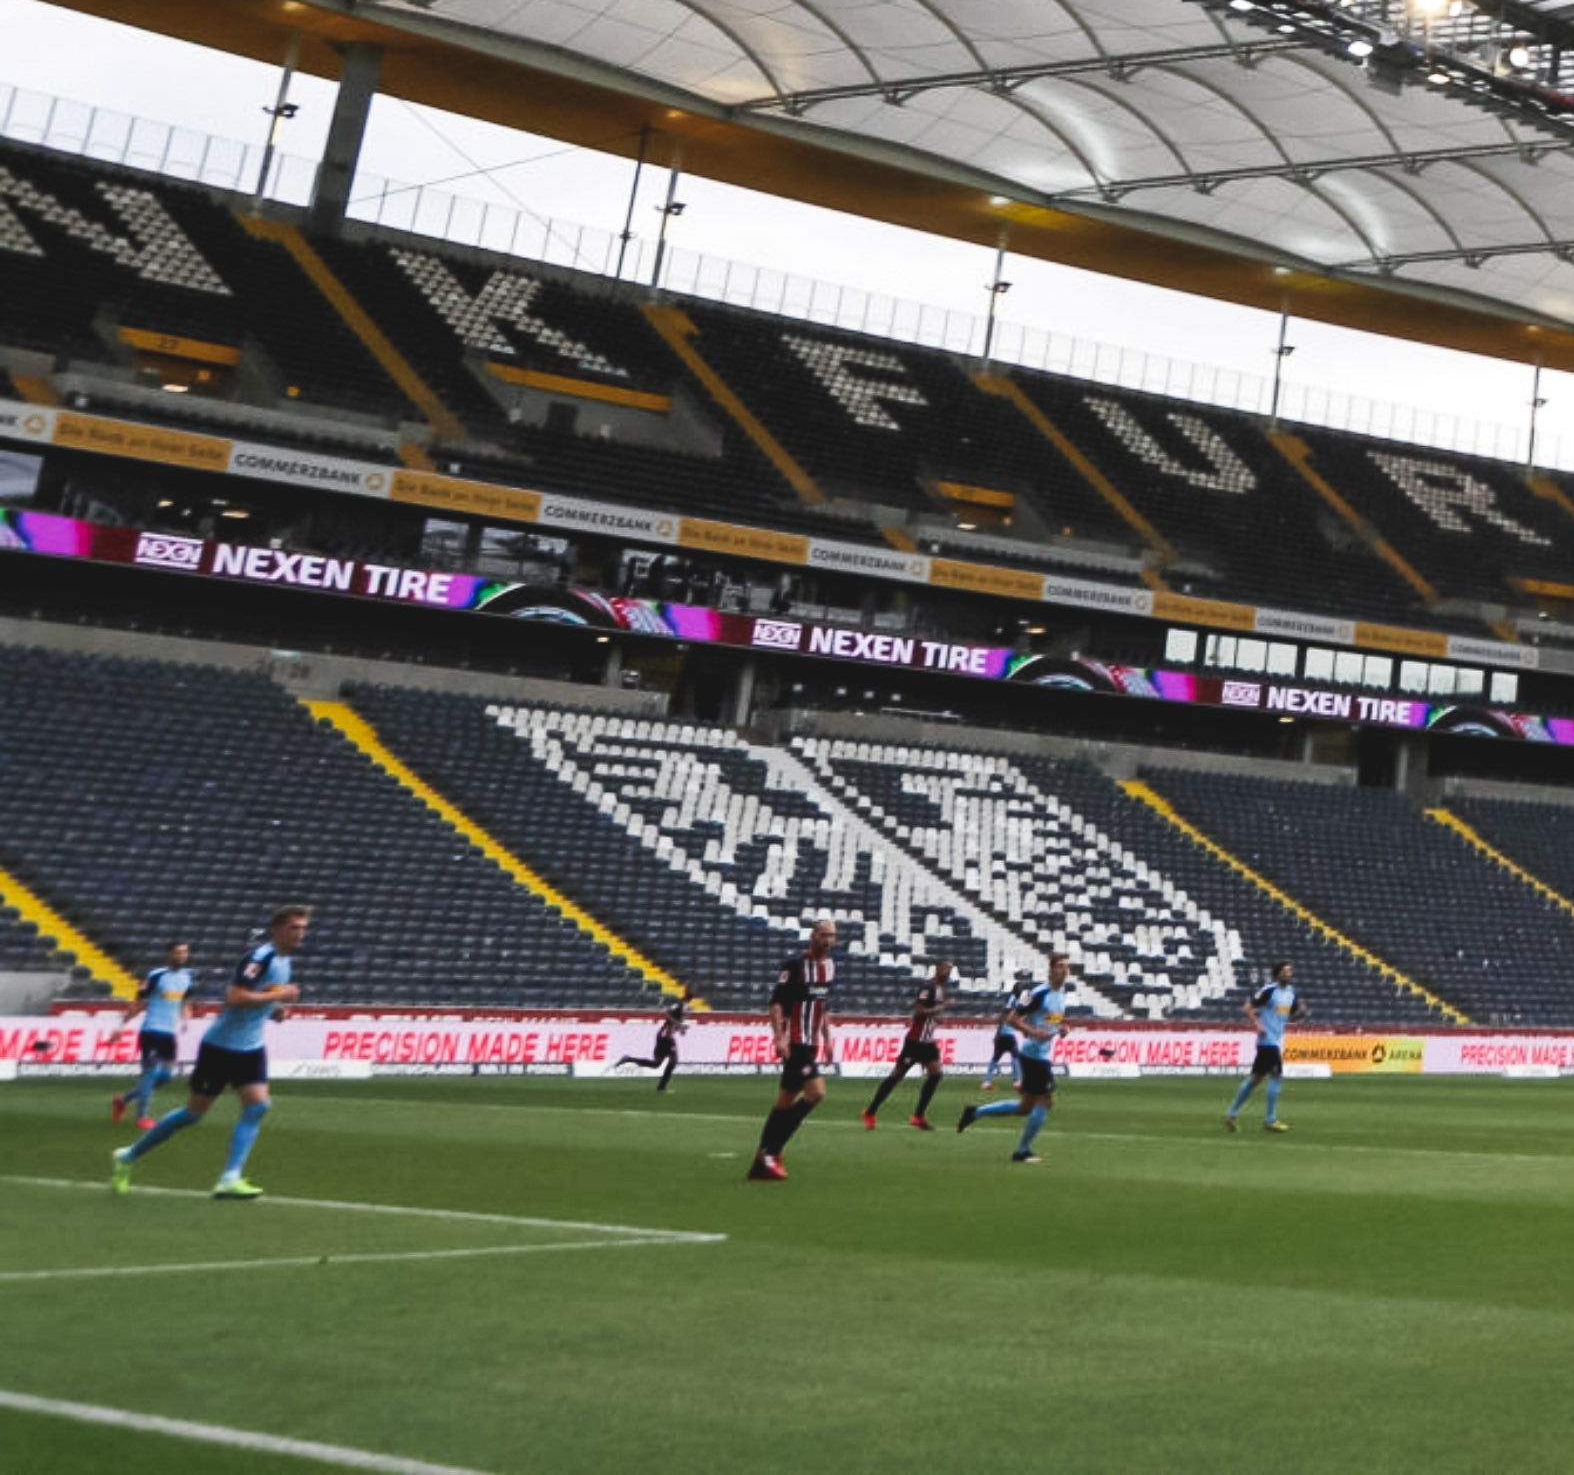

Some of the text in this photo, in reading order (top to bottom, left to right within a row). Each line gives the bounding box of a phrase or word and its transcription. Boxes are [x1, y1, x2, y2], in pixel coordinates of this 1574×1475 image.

[234, 453, 361, 485] COMMERZBANK
[212, 543, 354, 590] NEXEN
[363, 564, 454, 604] TIRE
[809, 626, 914, 664] NEXEN
[921, 641, 989, 673] TIRE
[1266, 686, 1351, 718] NEXEN
[1357, 696, 1412, 724] TIRE
[0, 1029, 84, 1061] MADE
[322, 1031, 609, 1063] PRECISION MADE HERE
[842, 1038, 899, 1063] MADE
[1053, 1039, 1240, 1065] PRECISION MADE HERE
[1461, 1045, 1528, 1066] PRECISION
[1532, 1046, 1567, 1066] MADE
